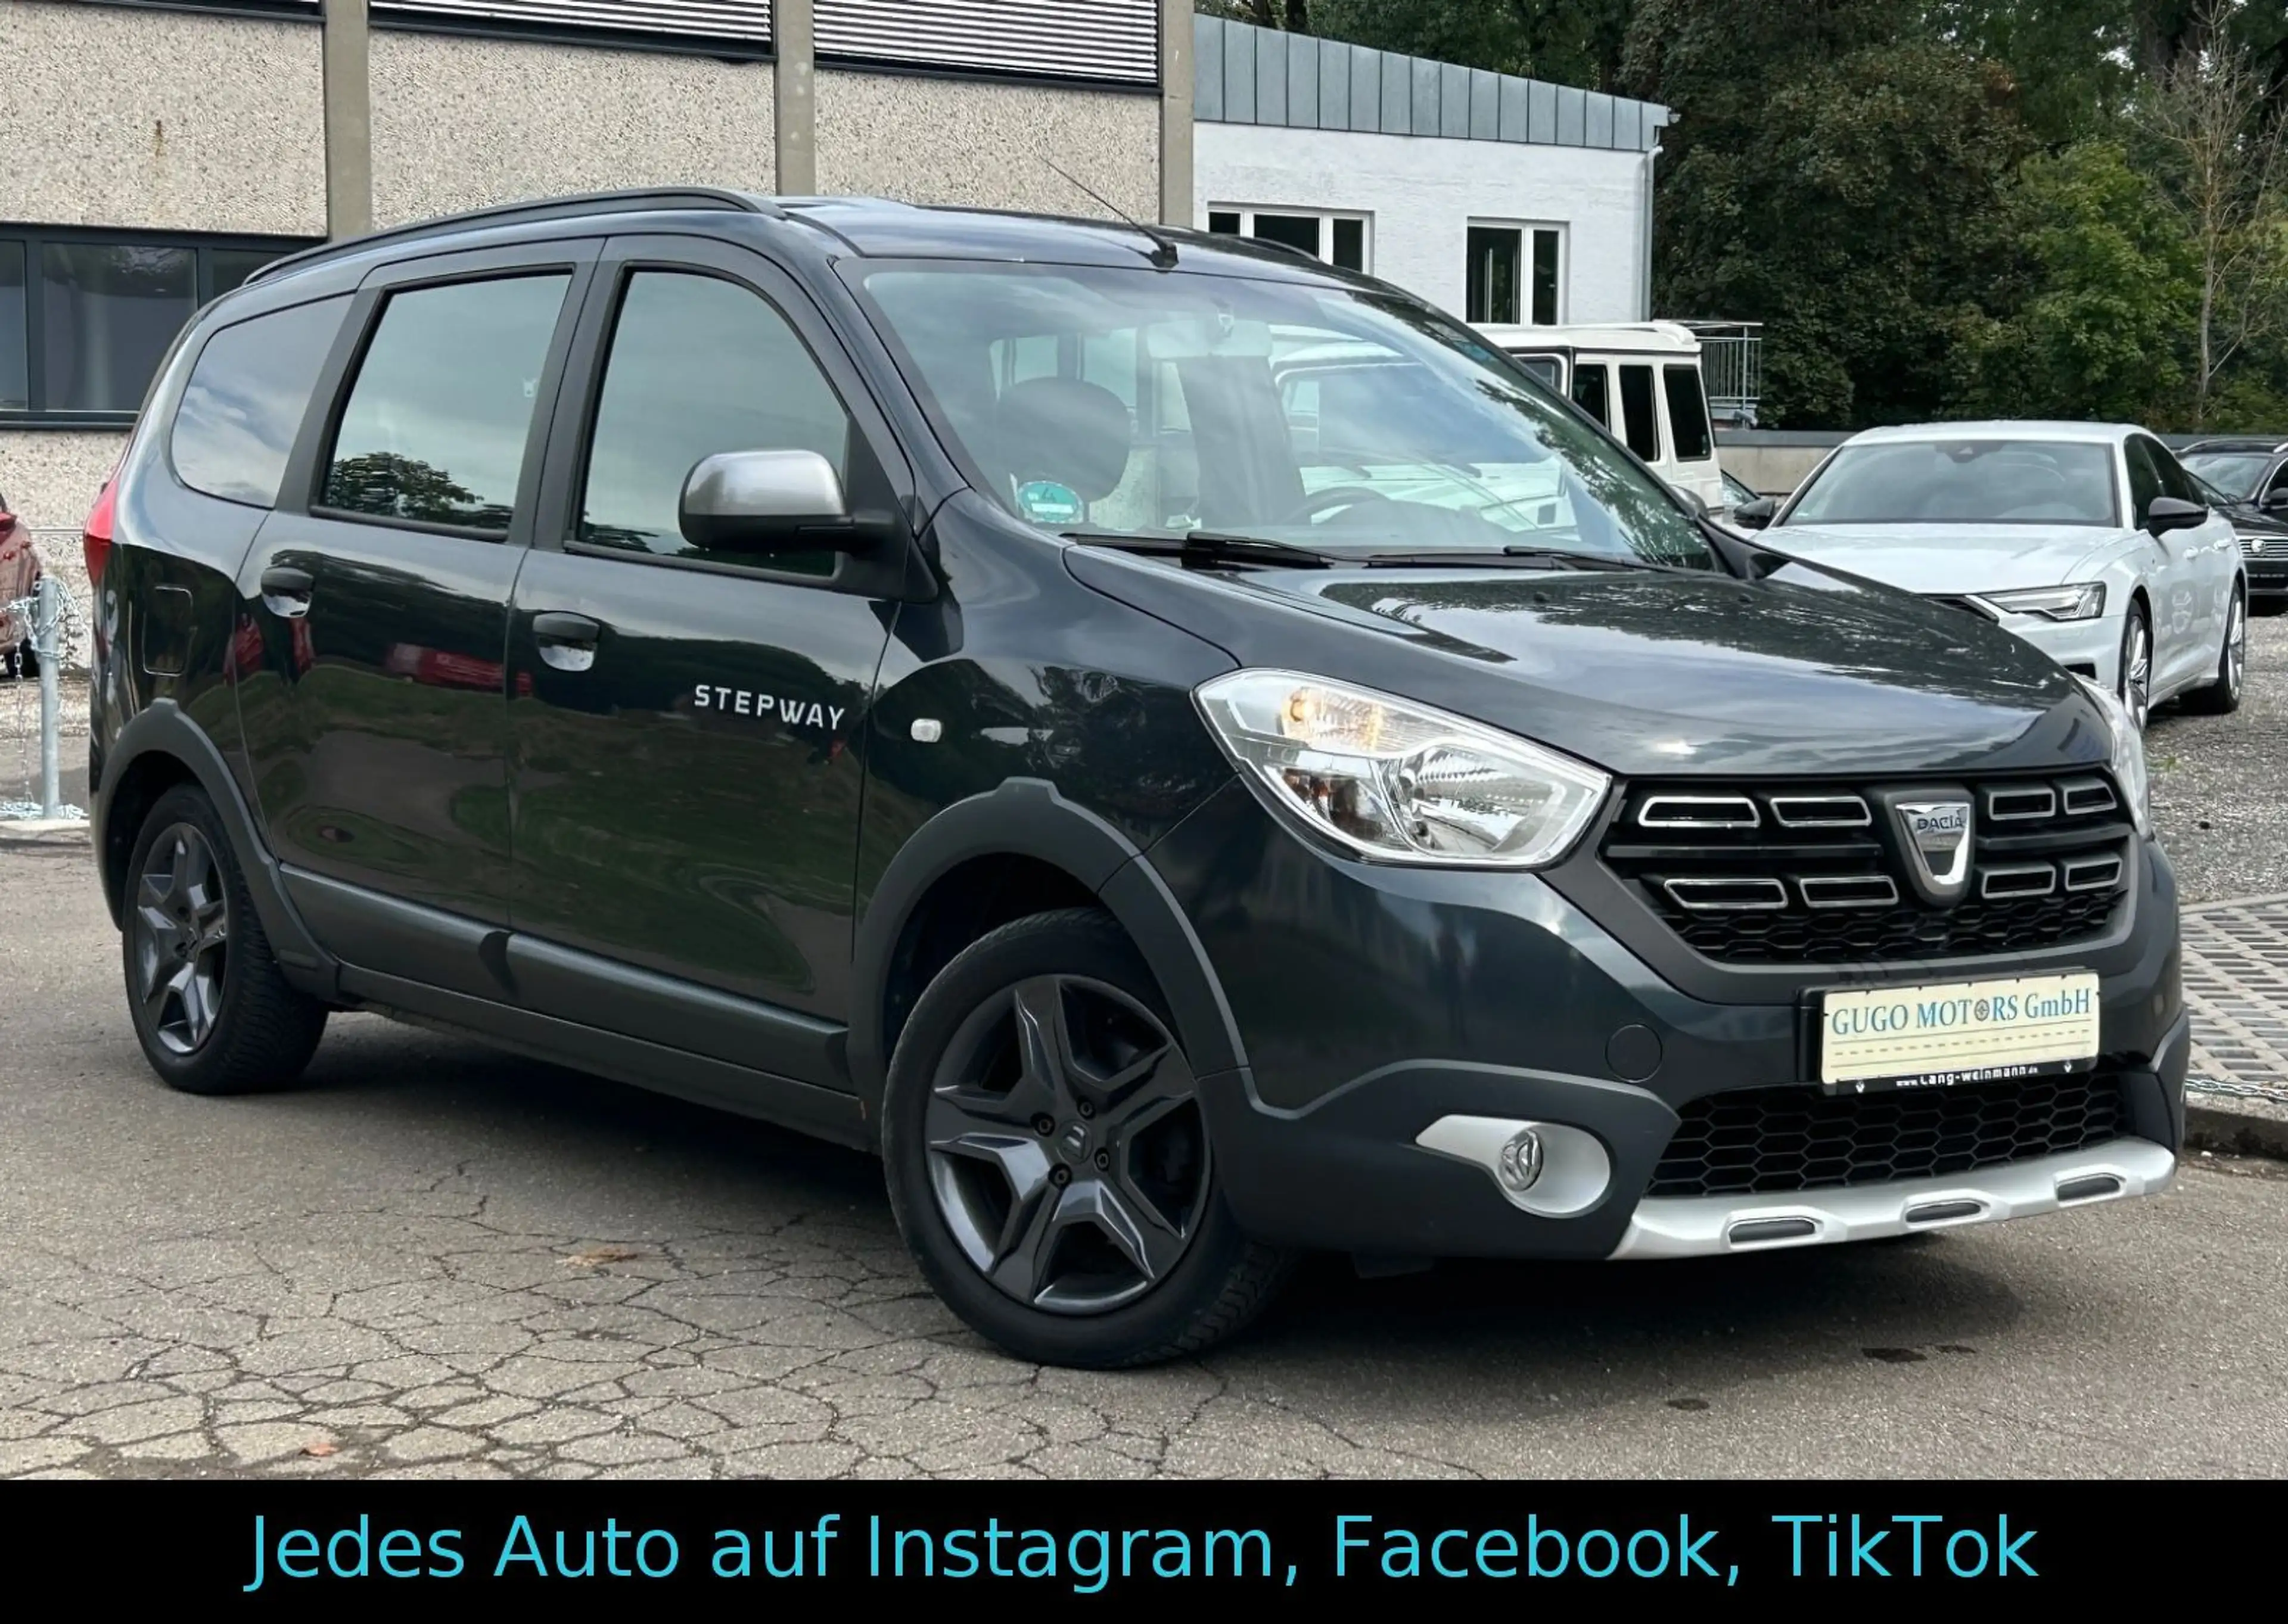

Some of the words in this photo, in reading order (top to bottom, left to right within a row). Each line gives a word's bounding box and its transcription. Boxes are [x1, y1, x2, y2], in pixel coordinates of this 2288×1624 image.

[694, 684, 845, 730] STEPWAY
[1917, 814, 1964, 830] DACIA
[1832, 1004, 1908, 1035] GUGO
[1916, 994, 2018, 1029] MOTORS
[2024, 988, 2091, 1019] GmbH
